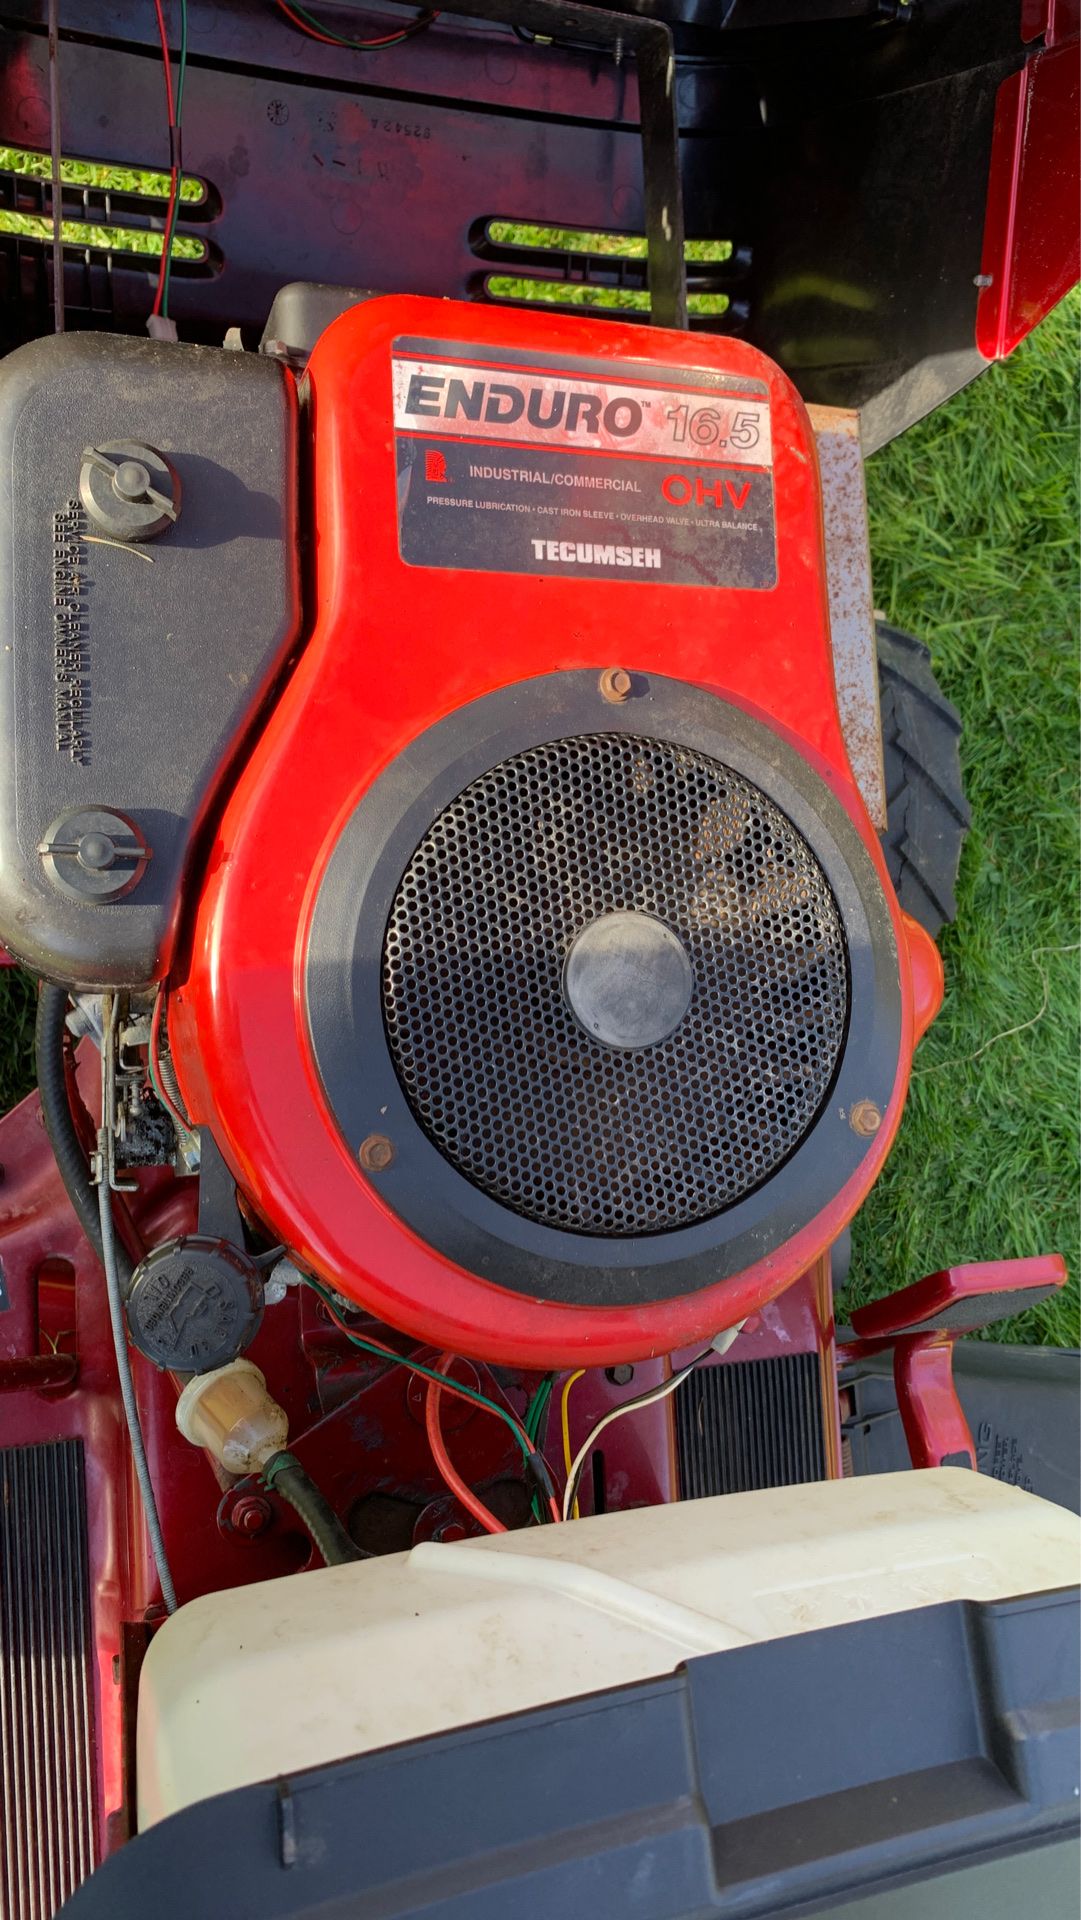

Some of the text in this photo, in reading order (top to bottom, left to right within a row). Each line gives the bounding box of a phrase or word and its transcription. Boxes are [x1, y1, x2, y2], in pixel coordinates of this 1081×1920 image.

[404, 374, 643, 437] ENDURO
[667, 404, 760, 450] 16.5
[469, 465, 642, 493] INDUSTRIAL/COMMERCIAL
[661, 474, 752, 511] OHV
[53, 513, 65, 543] SEE
[68, 499, 80, 566] SERVICE
[426, 496, 474, 508] PRESSURE
[475, 501, 531, 513] LUBRICATION
[537, 506, 559, 515] CAST
[560, 509, 581, 518] IRON
[582, 510, 614, 520] SLEEVE
[620, 514, 664, 524] OVERHEAD
[665, 517, 690, 526] VALVE
[695, 520, 720, 528] ULTRA
[721, 521, 758, 531] BALANCE
[53, 549, 66, 606] ENGINE
[531, 539, 661, 569] TECUMSEH
[69, 602, 81, 672] CLEANER
[55, 689, 68, 751] MANUAL
[70, 680, 82, 765] REGULARLY
